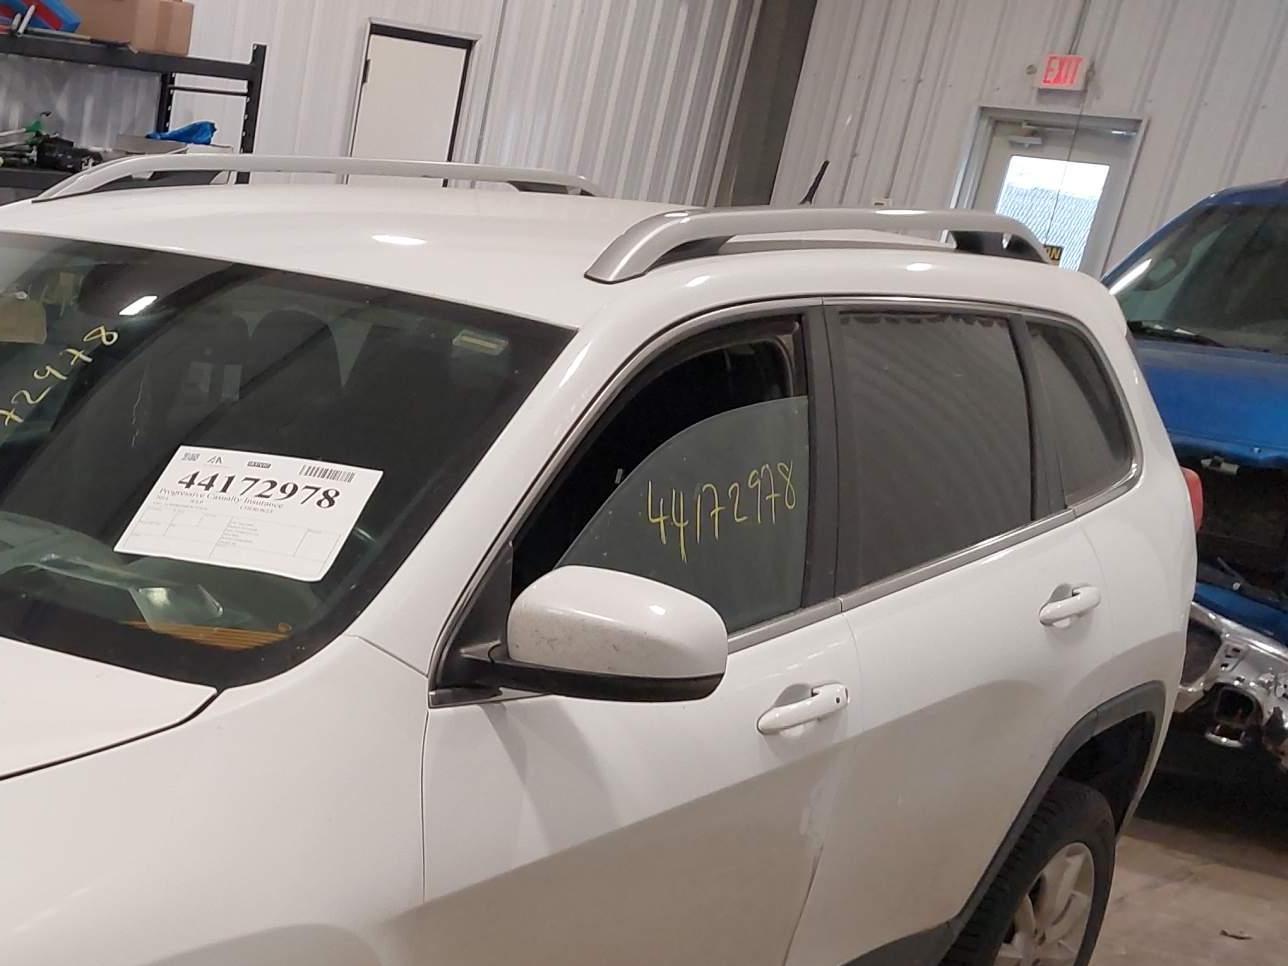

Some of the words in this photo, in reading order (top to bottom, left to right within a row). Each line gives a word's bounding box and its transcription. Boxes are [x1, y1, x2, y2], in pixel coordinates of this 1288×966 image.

[1042, 56, 1082, 84] EXIT
[159, 487, 205, 499] Progressive
[206, 493, 240, 503] Casualty
[243, 497, 284, 510] Insurance
[178, 470, 340, 509] 44172978
[647, 461, 797, 564] 44172978
